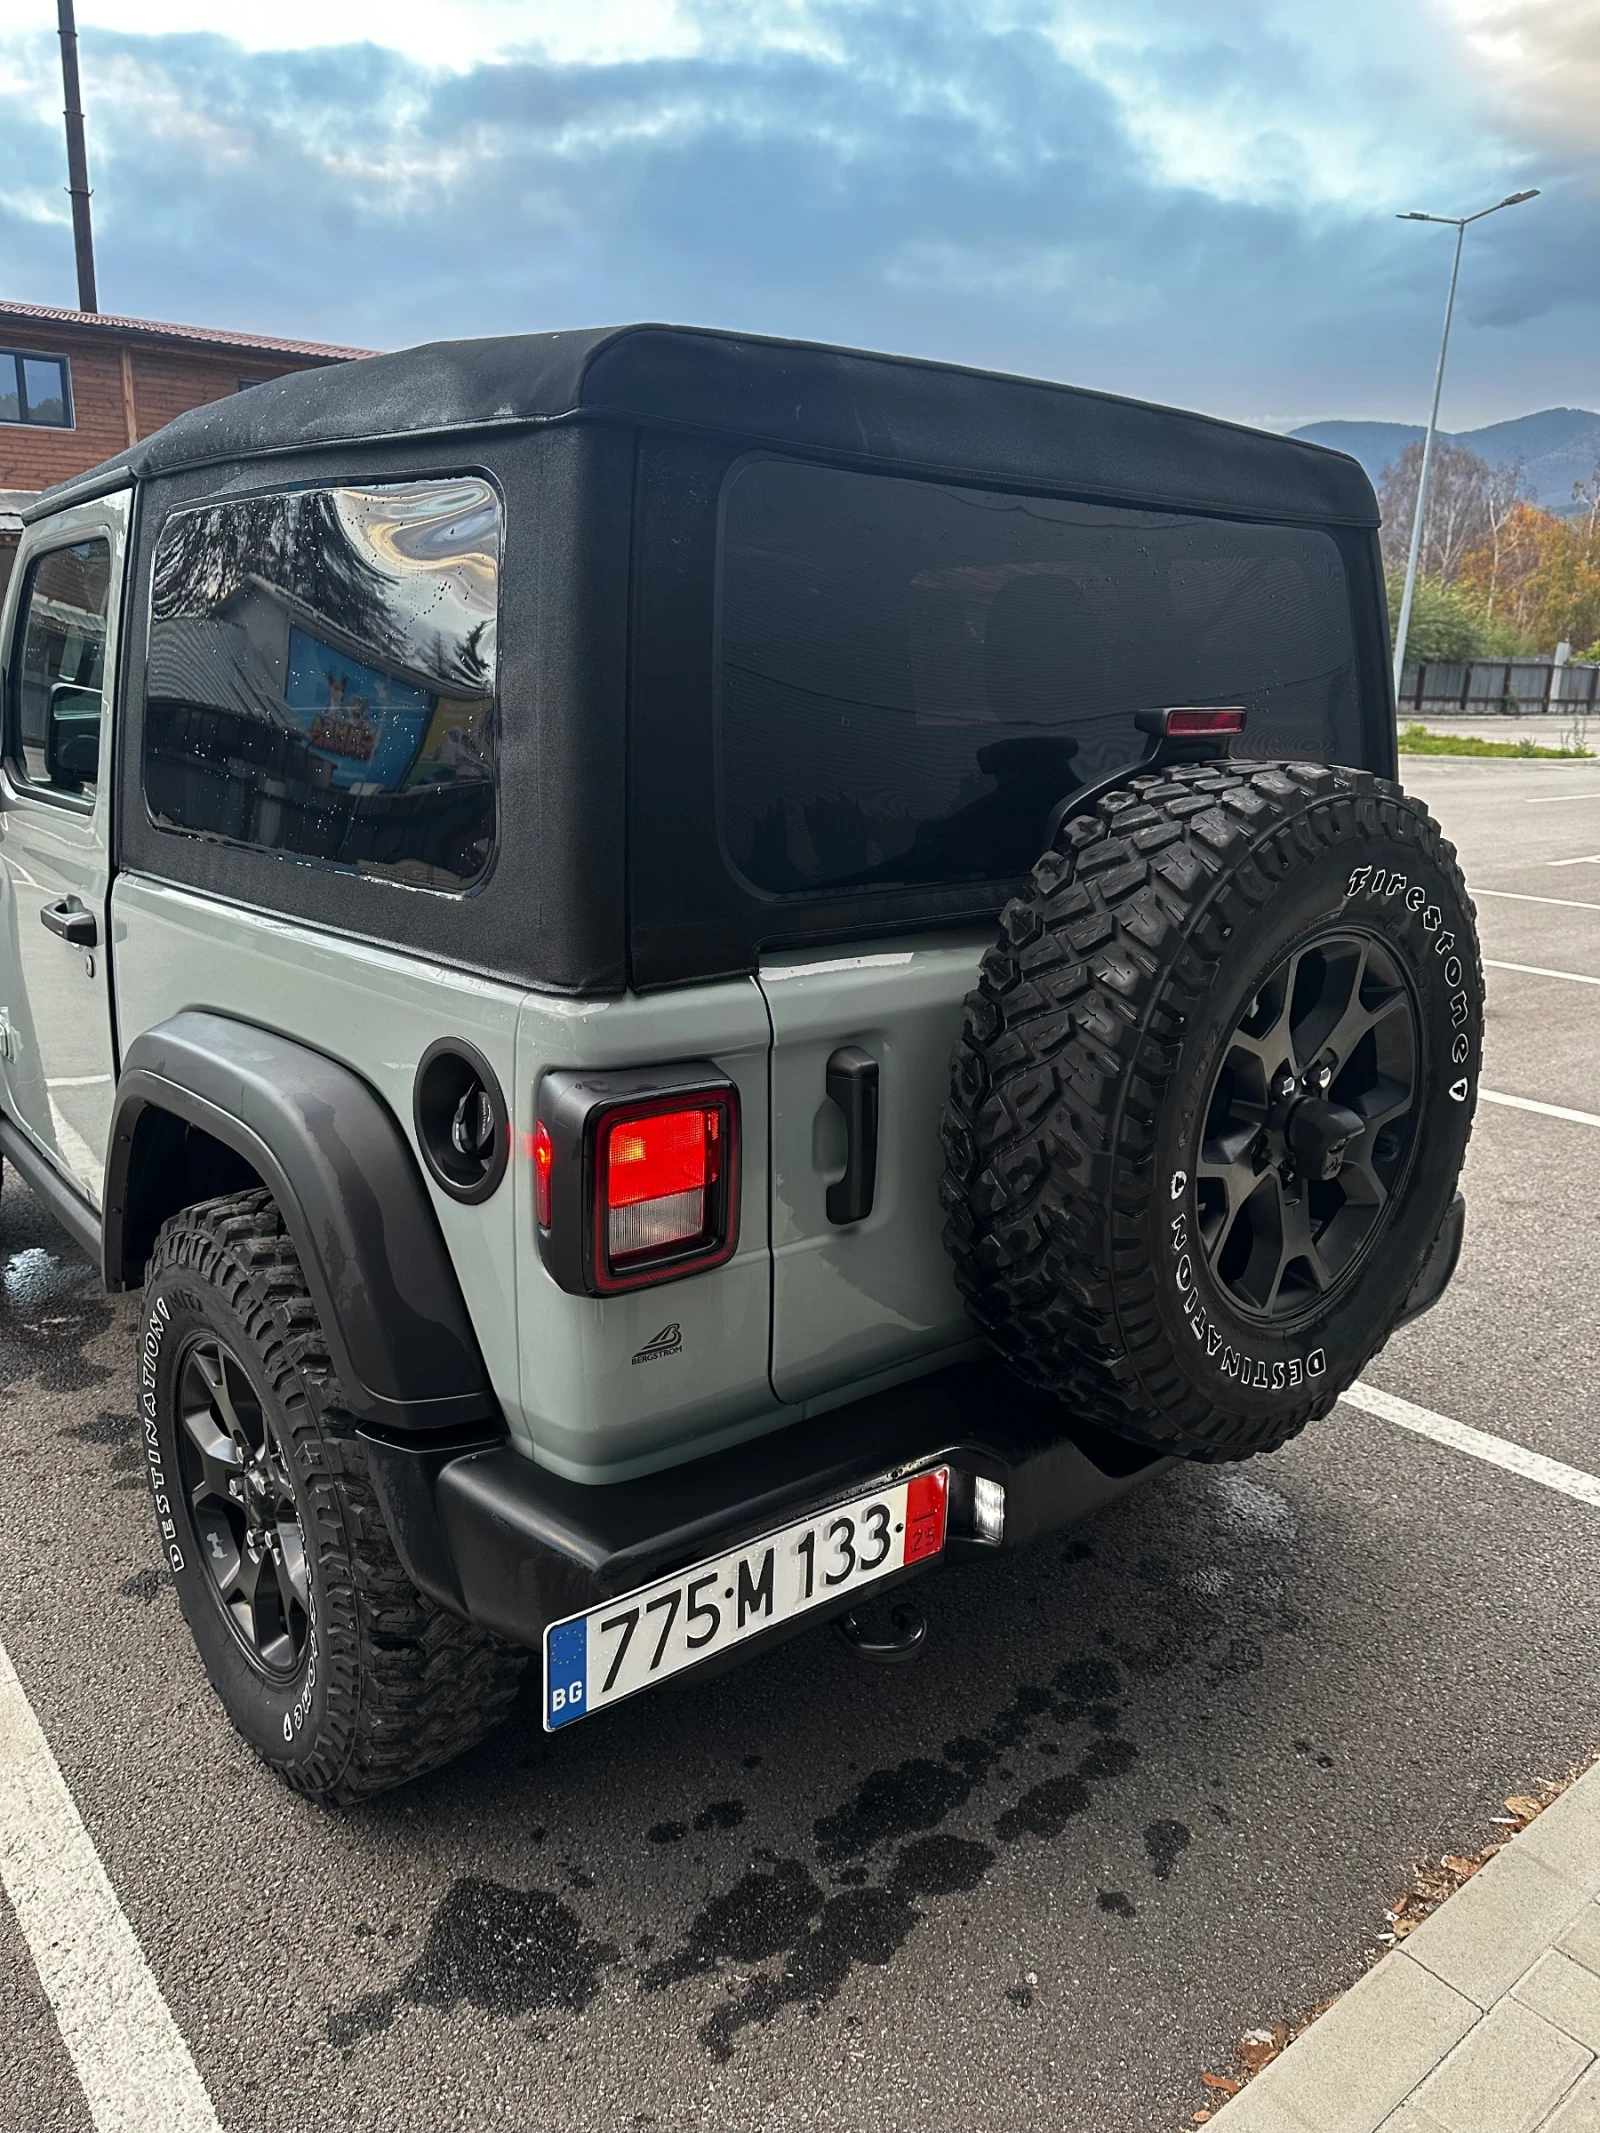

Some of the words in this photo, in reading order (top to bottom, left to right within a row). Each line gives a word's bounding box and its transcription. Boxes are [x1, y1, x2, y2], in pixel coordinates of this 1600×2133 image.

[1347, 865, 1469, 1065] Firestone
[631, 1345, 683, 1366] BERGSTROM
[1169, 1211, 1327, 1390] DESTINATION
[141, 1309, 186, 1573] DESTINATION
[600, 1573, 721, 1693] 775
[797, 1502, 892, 1599] 133
[911, 1525, 936, 1553] 25
[551, 1680, 583, 1713] BG
